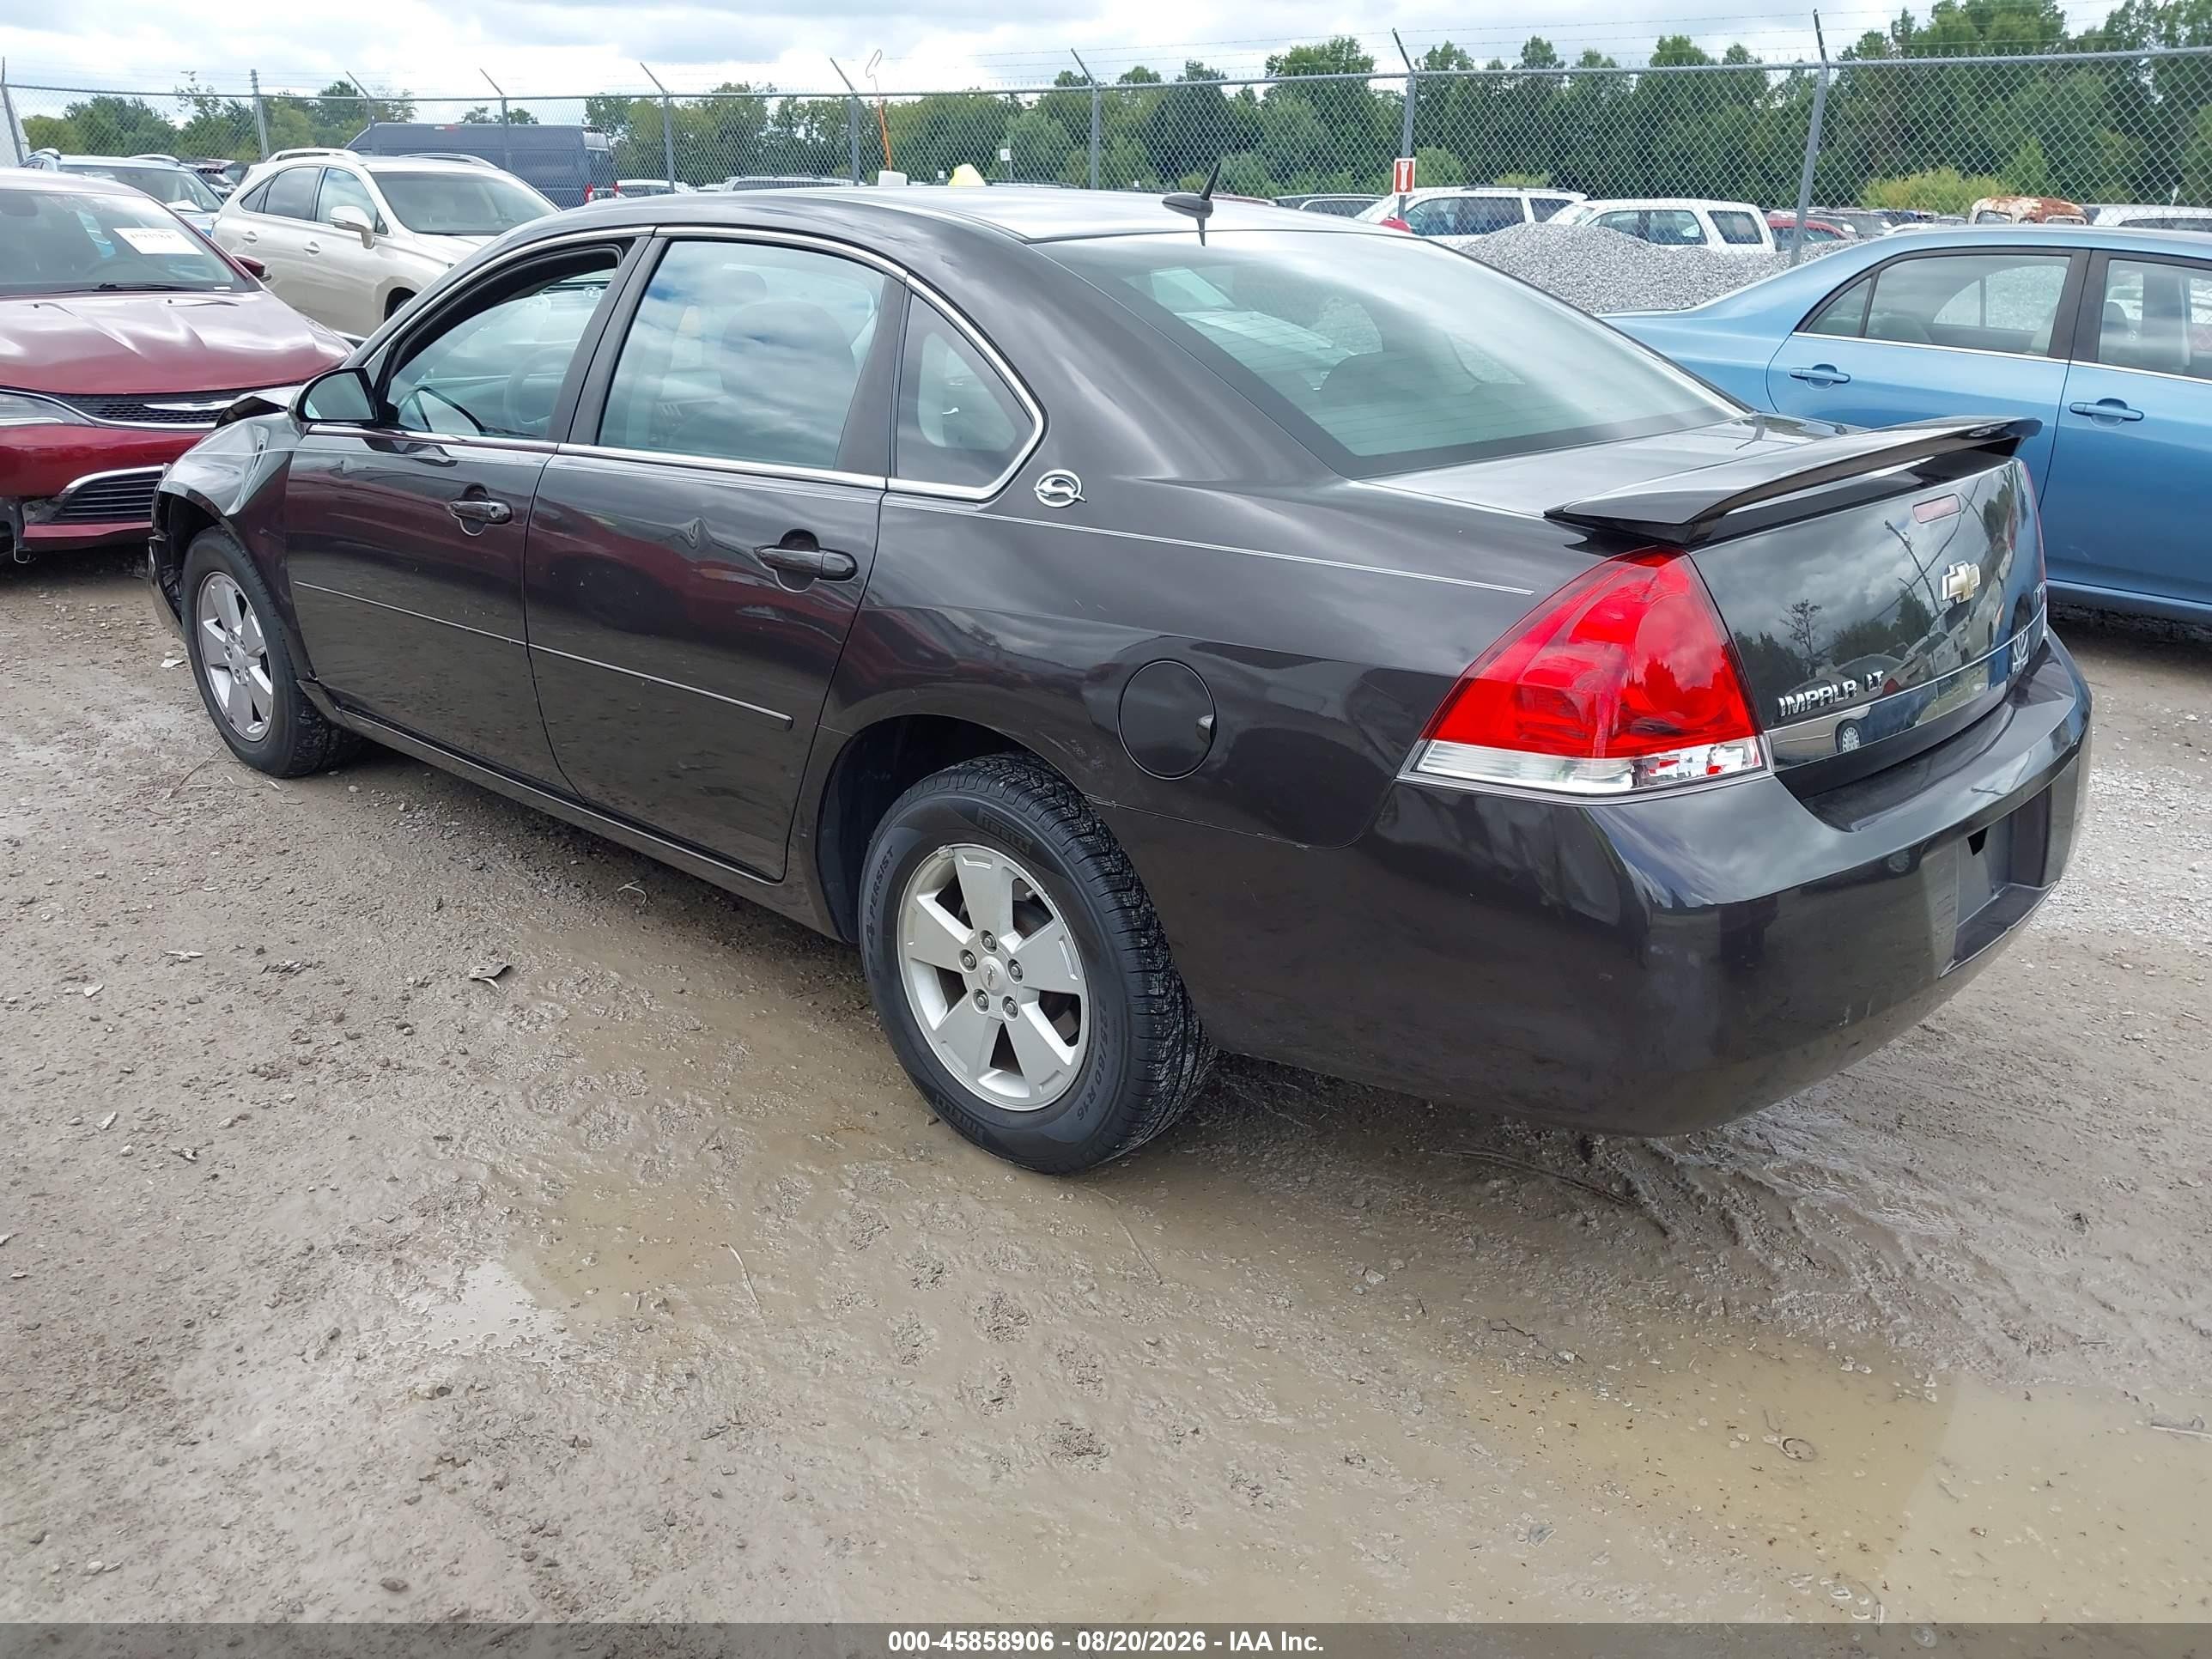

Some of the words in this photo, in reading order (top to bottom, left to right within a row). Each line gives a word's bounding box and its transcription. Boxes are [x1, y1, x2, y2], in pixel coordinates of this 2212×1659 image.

[1778, 679, 1857, 717] IMPALA
[1864, 670, 1884, 692] LT
[869, 845, 894, 920] PERSIST
